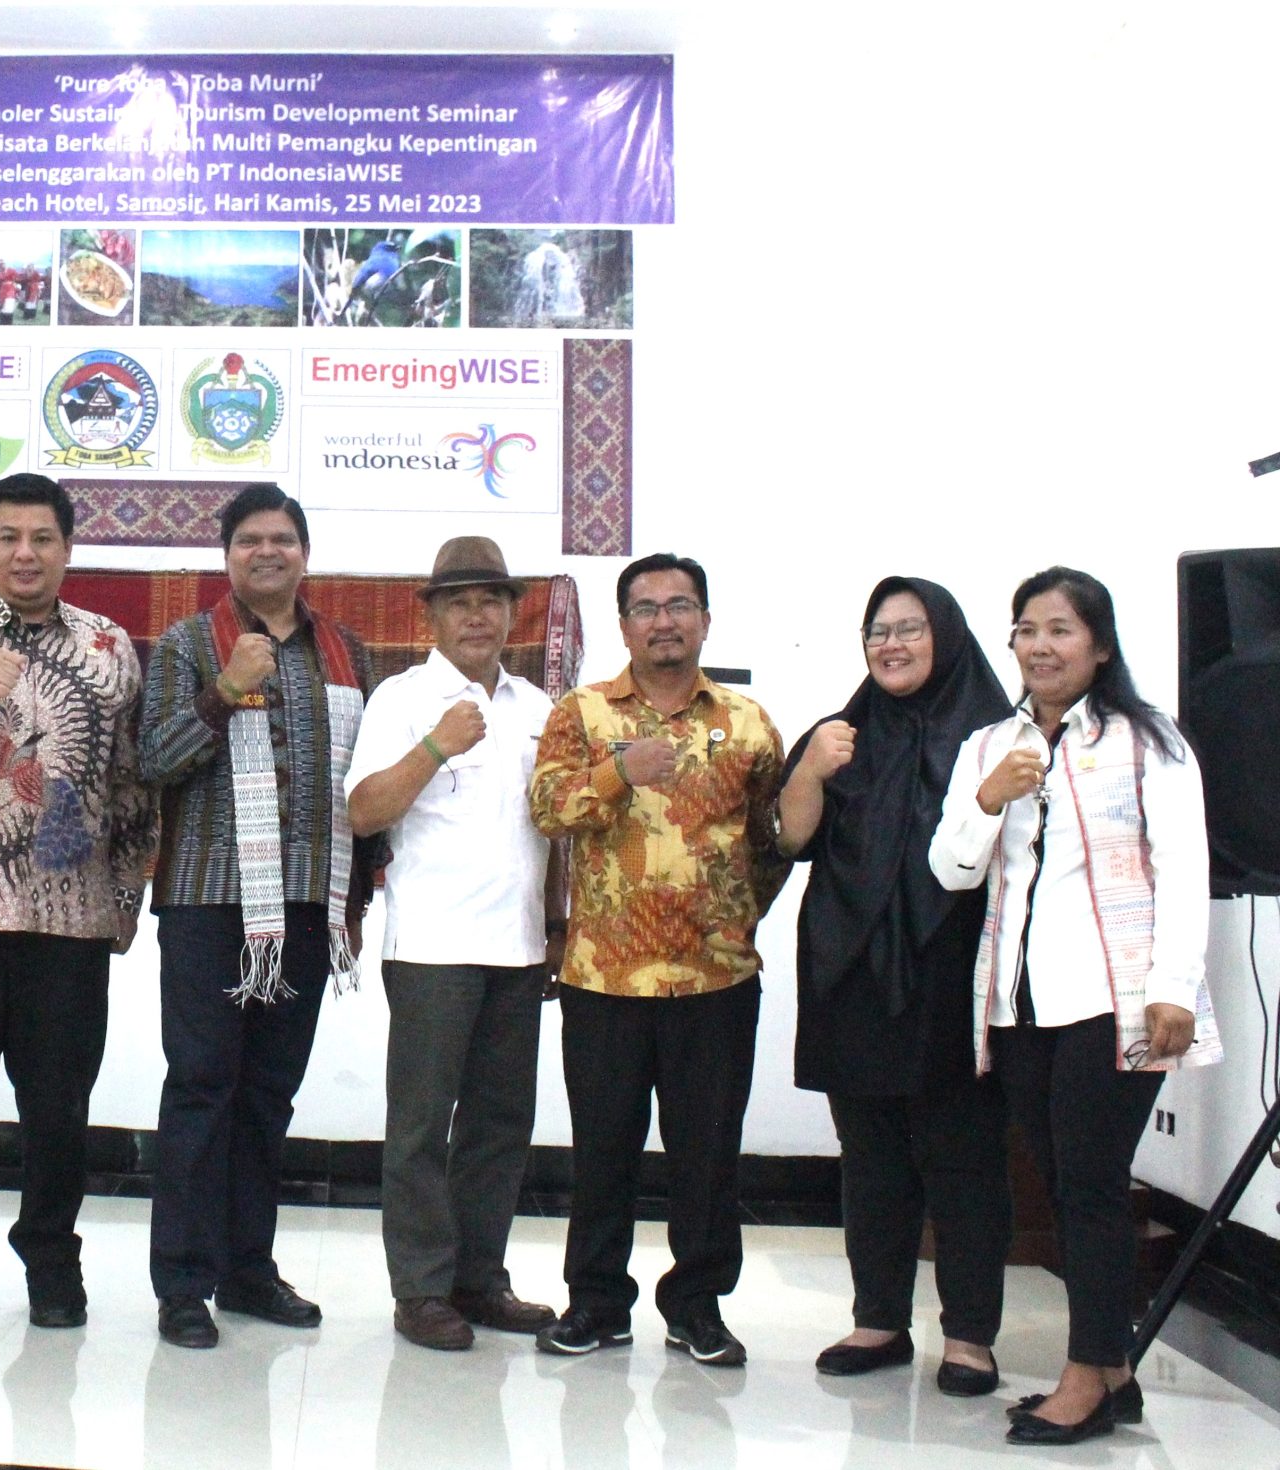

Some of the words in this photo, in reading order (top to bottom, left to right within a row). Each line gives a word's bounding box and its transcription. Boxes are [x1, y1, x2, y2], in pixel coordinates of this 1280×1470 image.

[191, 74, 242, 92] Toba
[180, 102, 265, 122] Tourism
[273, 104, 420, 126] Development
[427, 104, 518, 123] Seminar
[213, 132, 271, 151] Multi
[278, 134, 392, 155] Pemangku
[399, 134, 538, 156] Kepentingan
[152, 162, 199, 182] oleh
[206, 163, 233, 181] PT
[240, 162, 403, 182] IndonesiaWISE
[46, 193, 110, 215] Hotel,
[116, 193, 208, 214] Samosir,
[214, 193, 260, 212] Hari
[267, 193, 338, 215] Kamis,
[345, 194, 372, 212] 25
[379, 194, 421, 212] Mei
[427, 194, 482, 213] 2023
[312, 357, 540, 389] EmergingWISE
[325, 433, 422, 447] wonderful
[323, 448, 461, 471] indonesia
